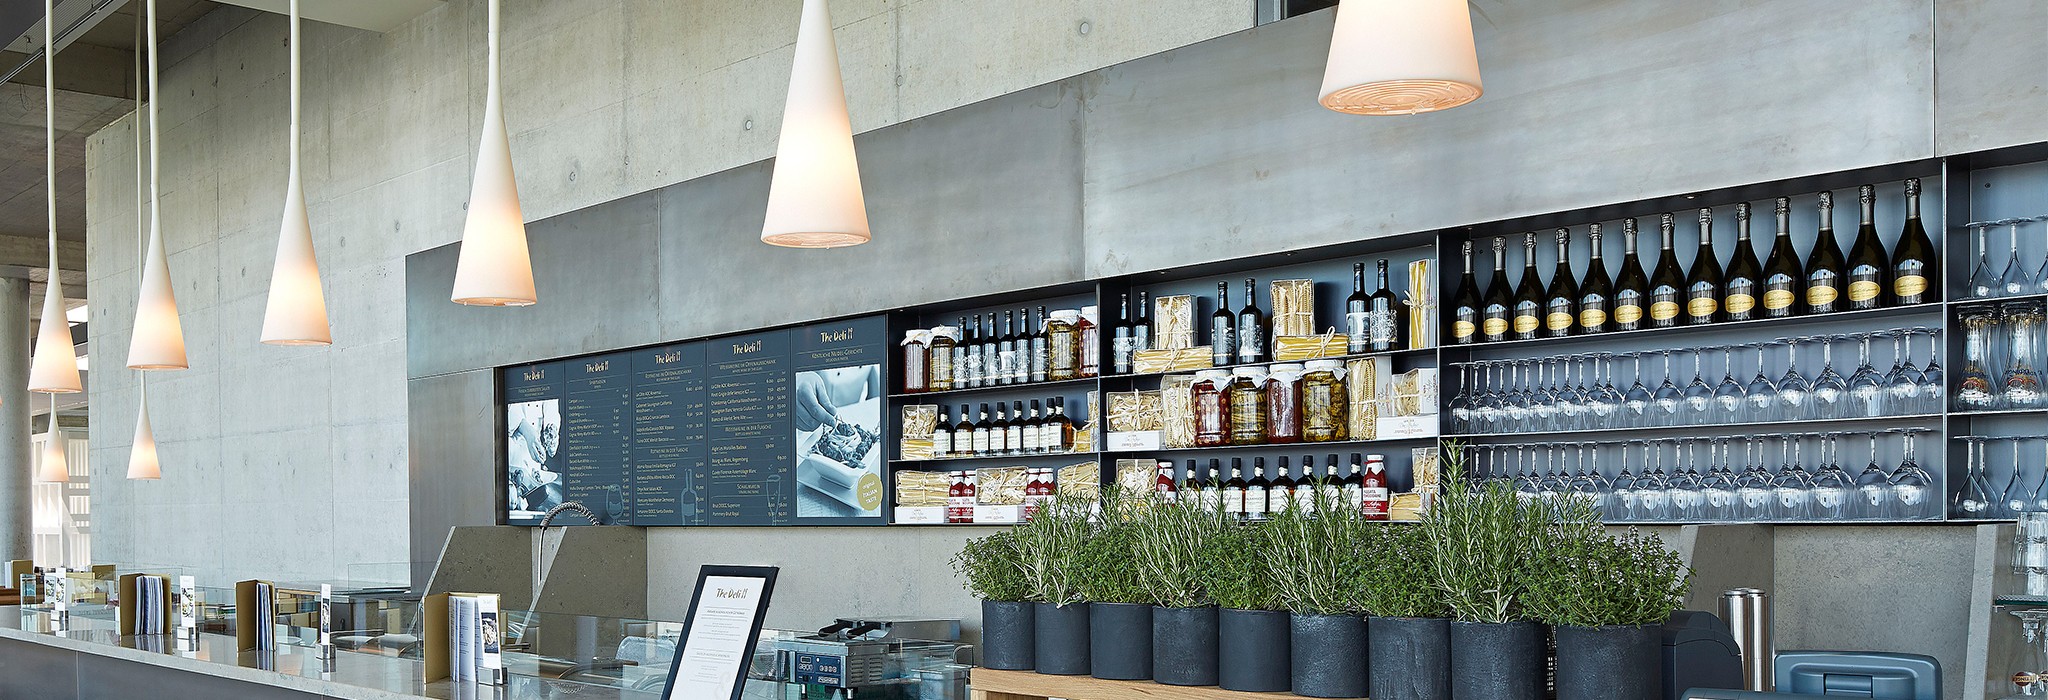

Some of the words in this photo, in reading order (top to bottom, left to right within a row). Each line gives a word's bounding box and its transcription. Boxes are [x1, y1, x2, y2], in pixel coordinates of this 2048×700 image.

[820, 330, 833, 344] The
[833, 328, 847, 342] Deli
[732, 342, 744, 355] The
[744, 341, 756, 354] Deli
[655, 353, 665, 365] The
[665, 352, 676, 364] Deli
[586, 362, 594, 374] The
[866, 496, 877, 504] TASTE
[716, 588, 728, 598] The
[728, 587, 742, 598] Deli
